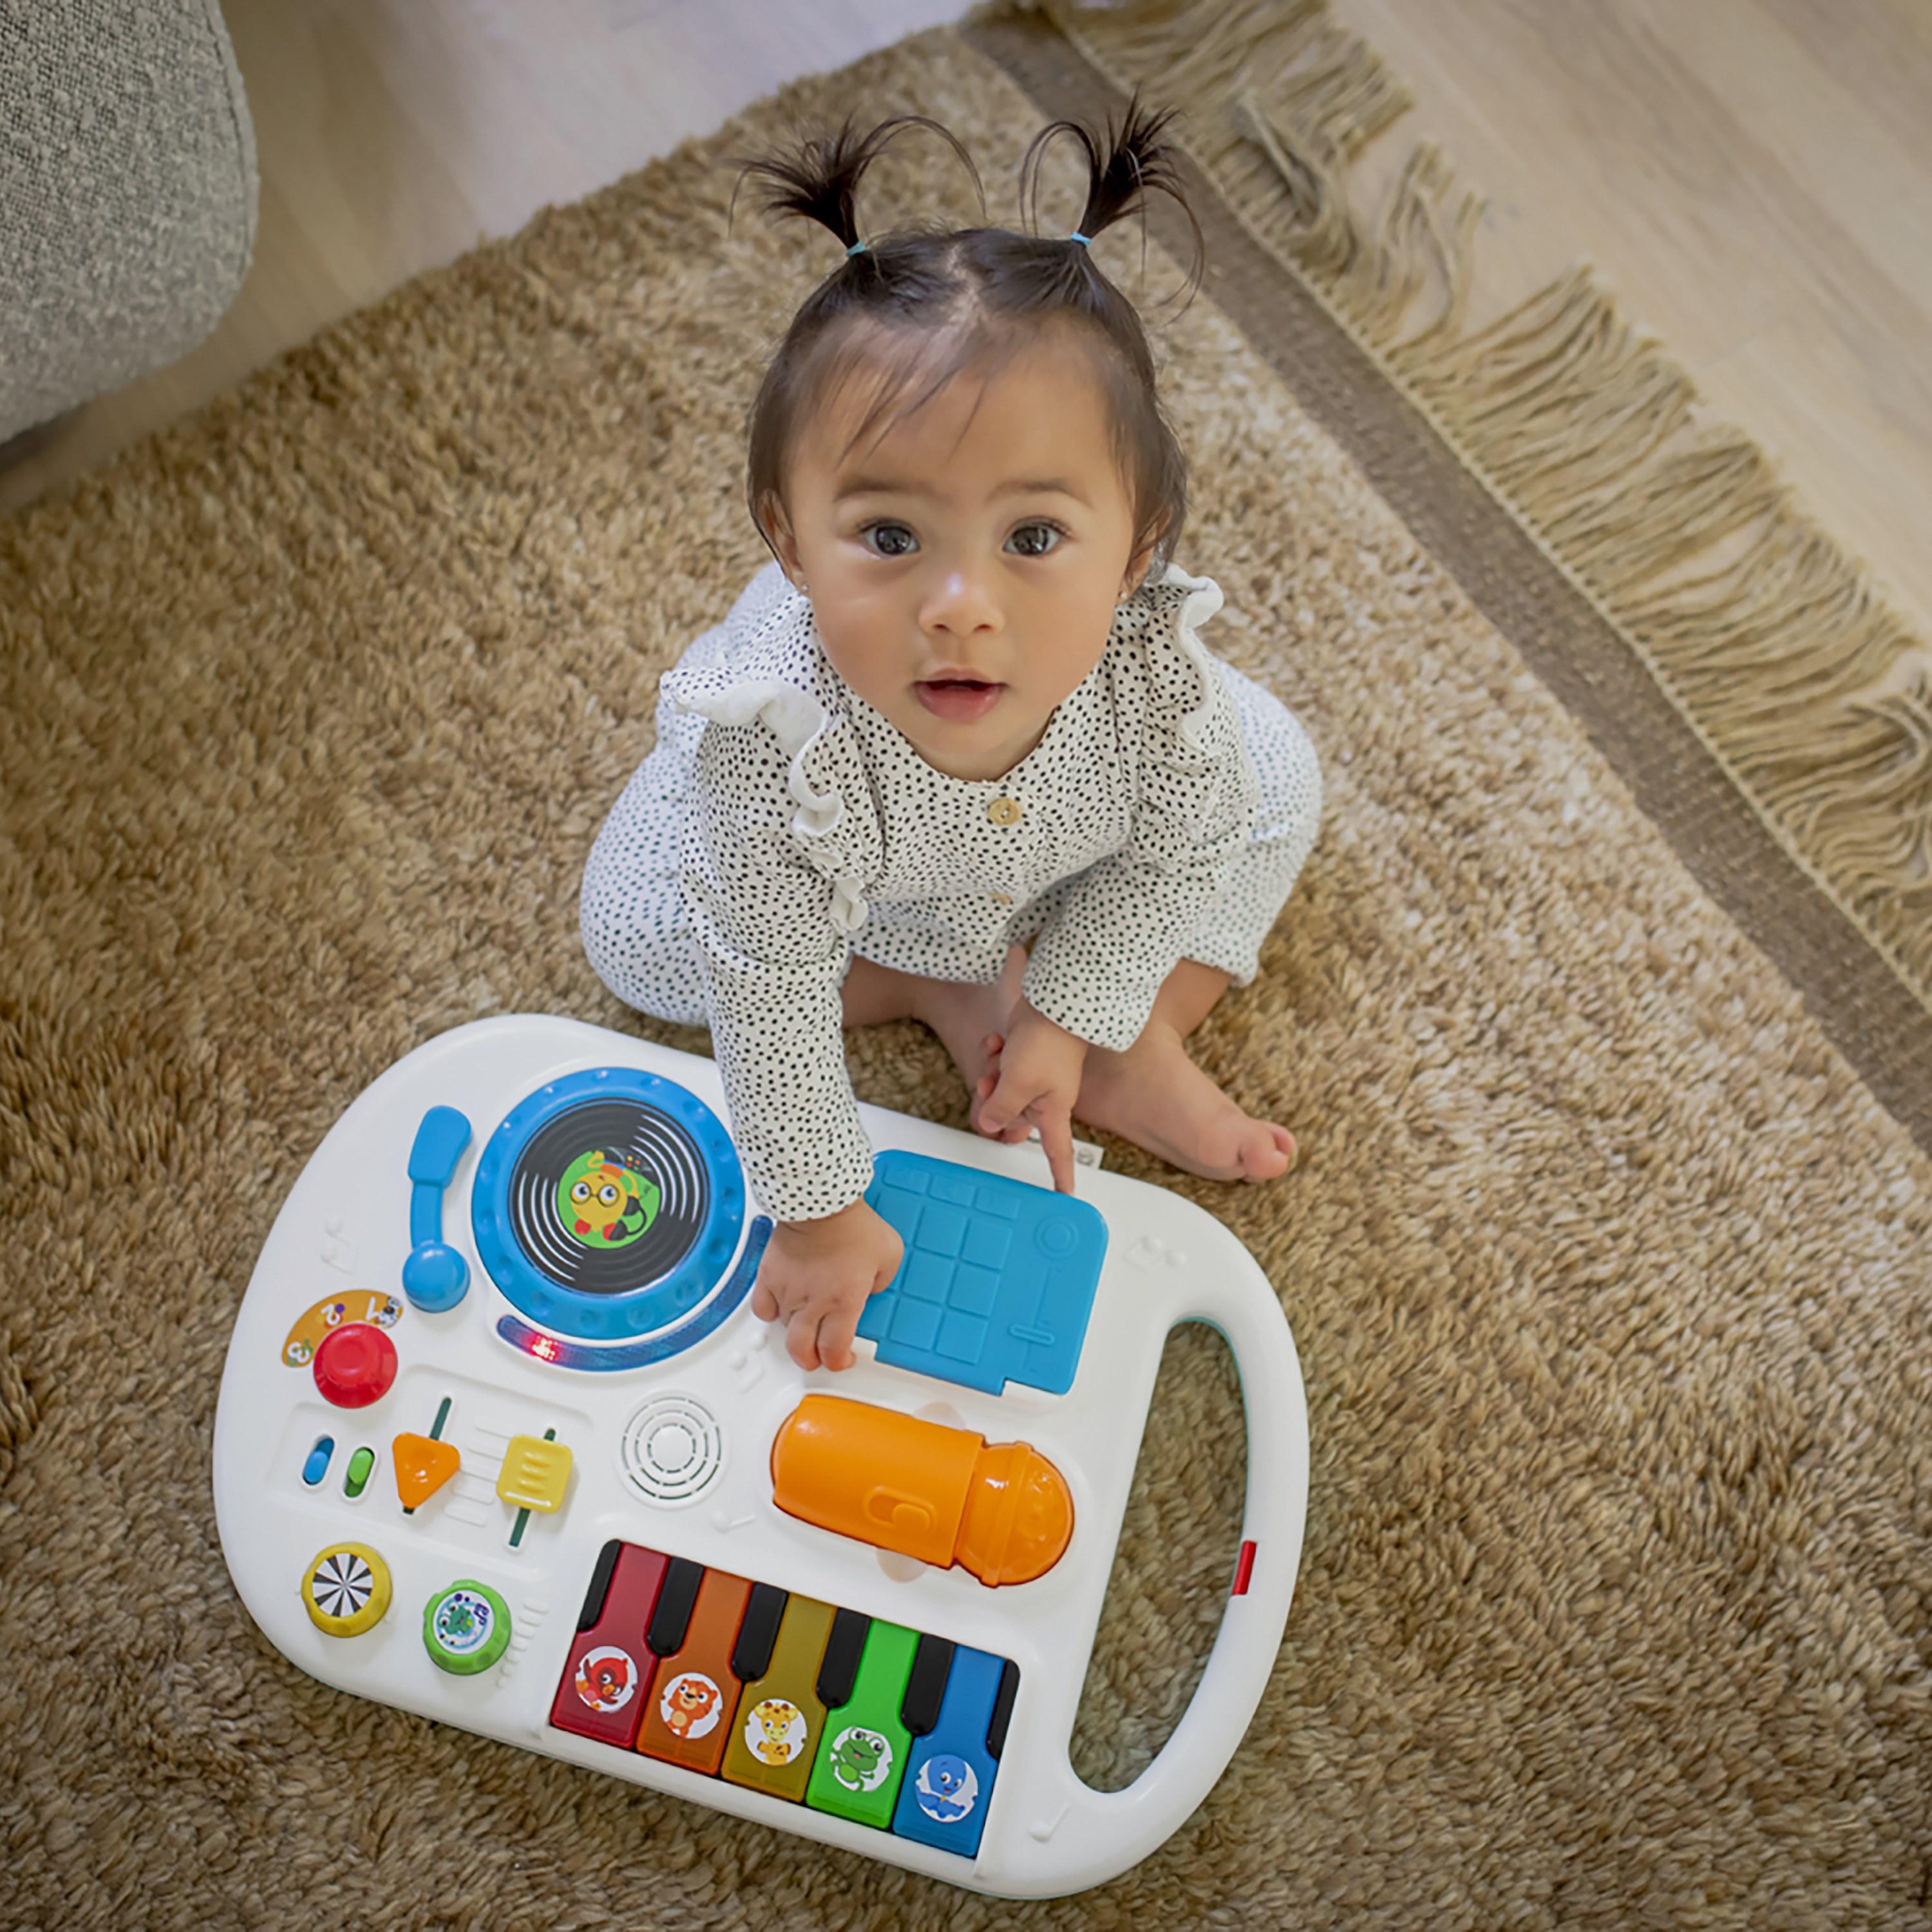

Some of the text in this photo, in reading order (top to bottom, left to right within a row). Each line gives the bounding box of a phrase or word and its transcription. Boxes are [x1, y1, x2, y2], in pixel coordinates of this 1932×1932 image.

[288, 1296, 381, 1363] 1 2 3
